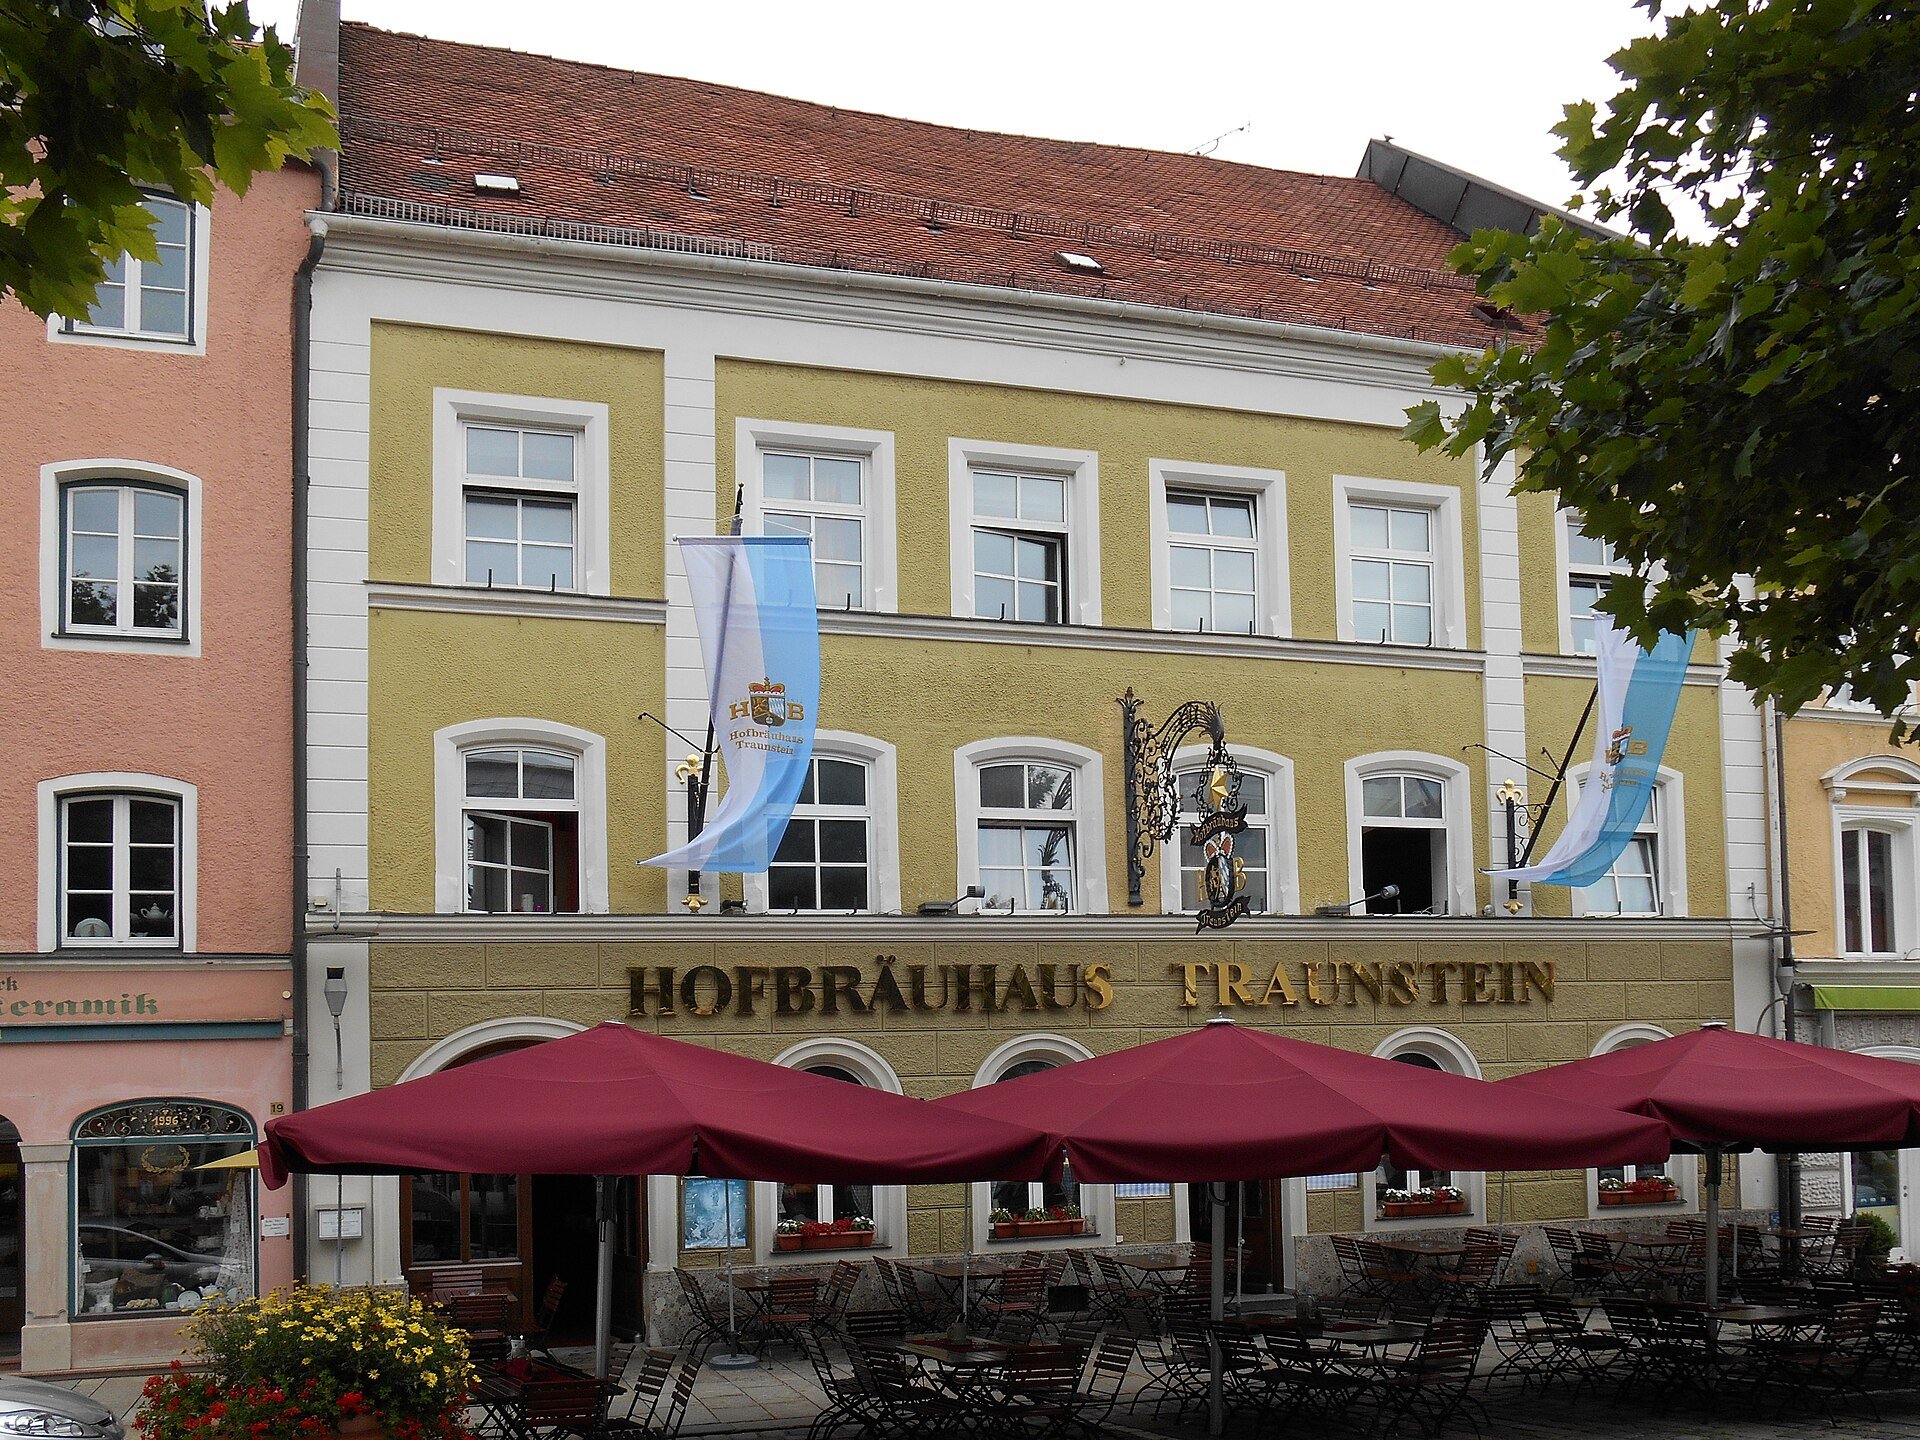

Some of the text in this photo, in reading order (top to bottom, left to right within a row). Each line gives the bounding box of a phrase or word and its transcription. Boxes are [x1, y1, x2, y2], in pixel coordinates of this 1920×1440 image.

[729, 728, 804, 744] Hofbräuhaus
[735, 740, 794, 755] Traunstein
[1194, 815, 1239, 843] Hofbräuhaus
[1201, 902, 1242, 927] Traunstein
[626, 954, 1557, 1016] HOFBRÄUHAUS TRAUNSTEIN
[271, 1103, 284, 1113] 19
[152, 1115, 179, 1126] 1996
